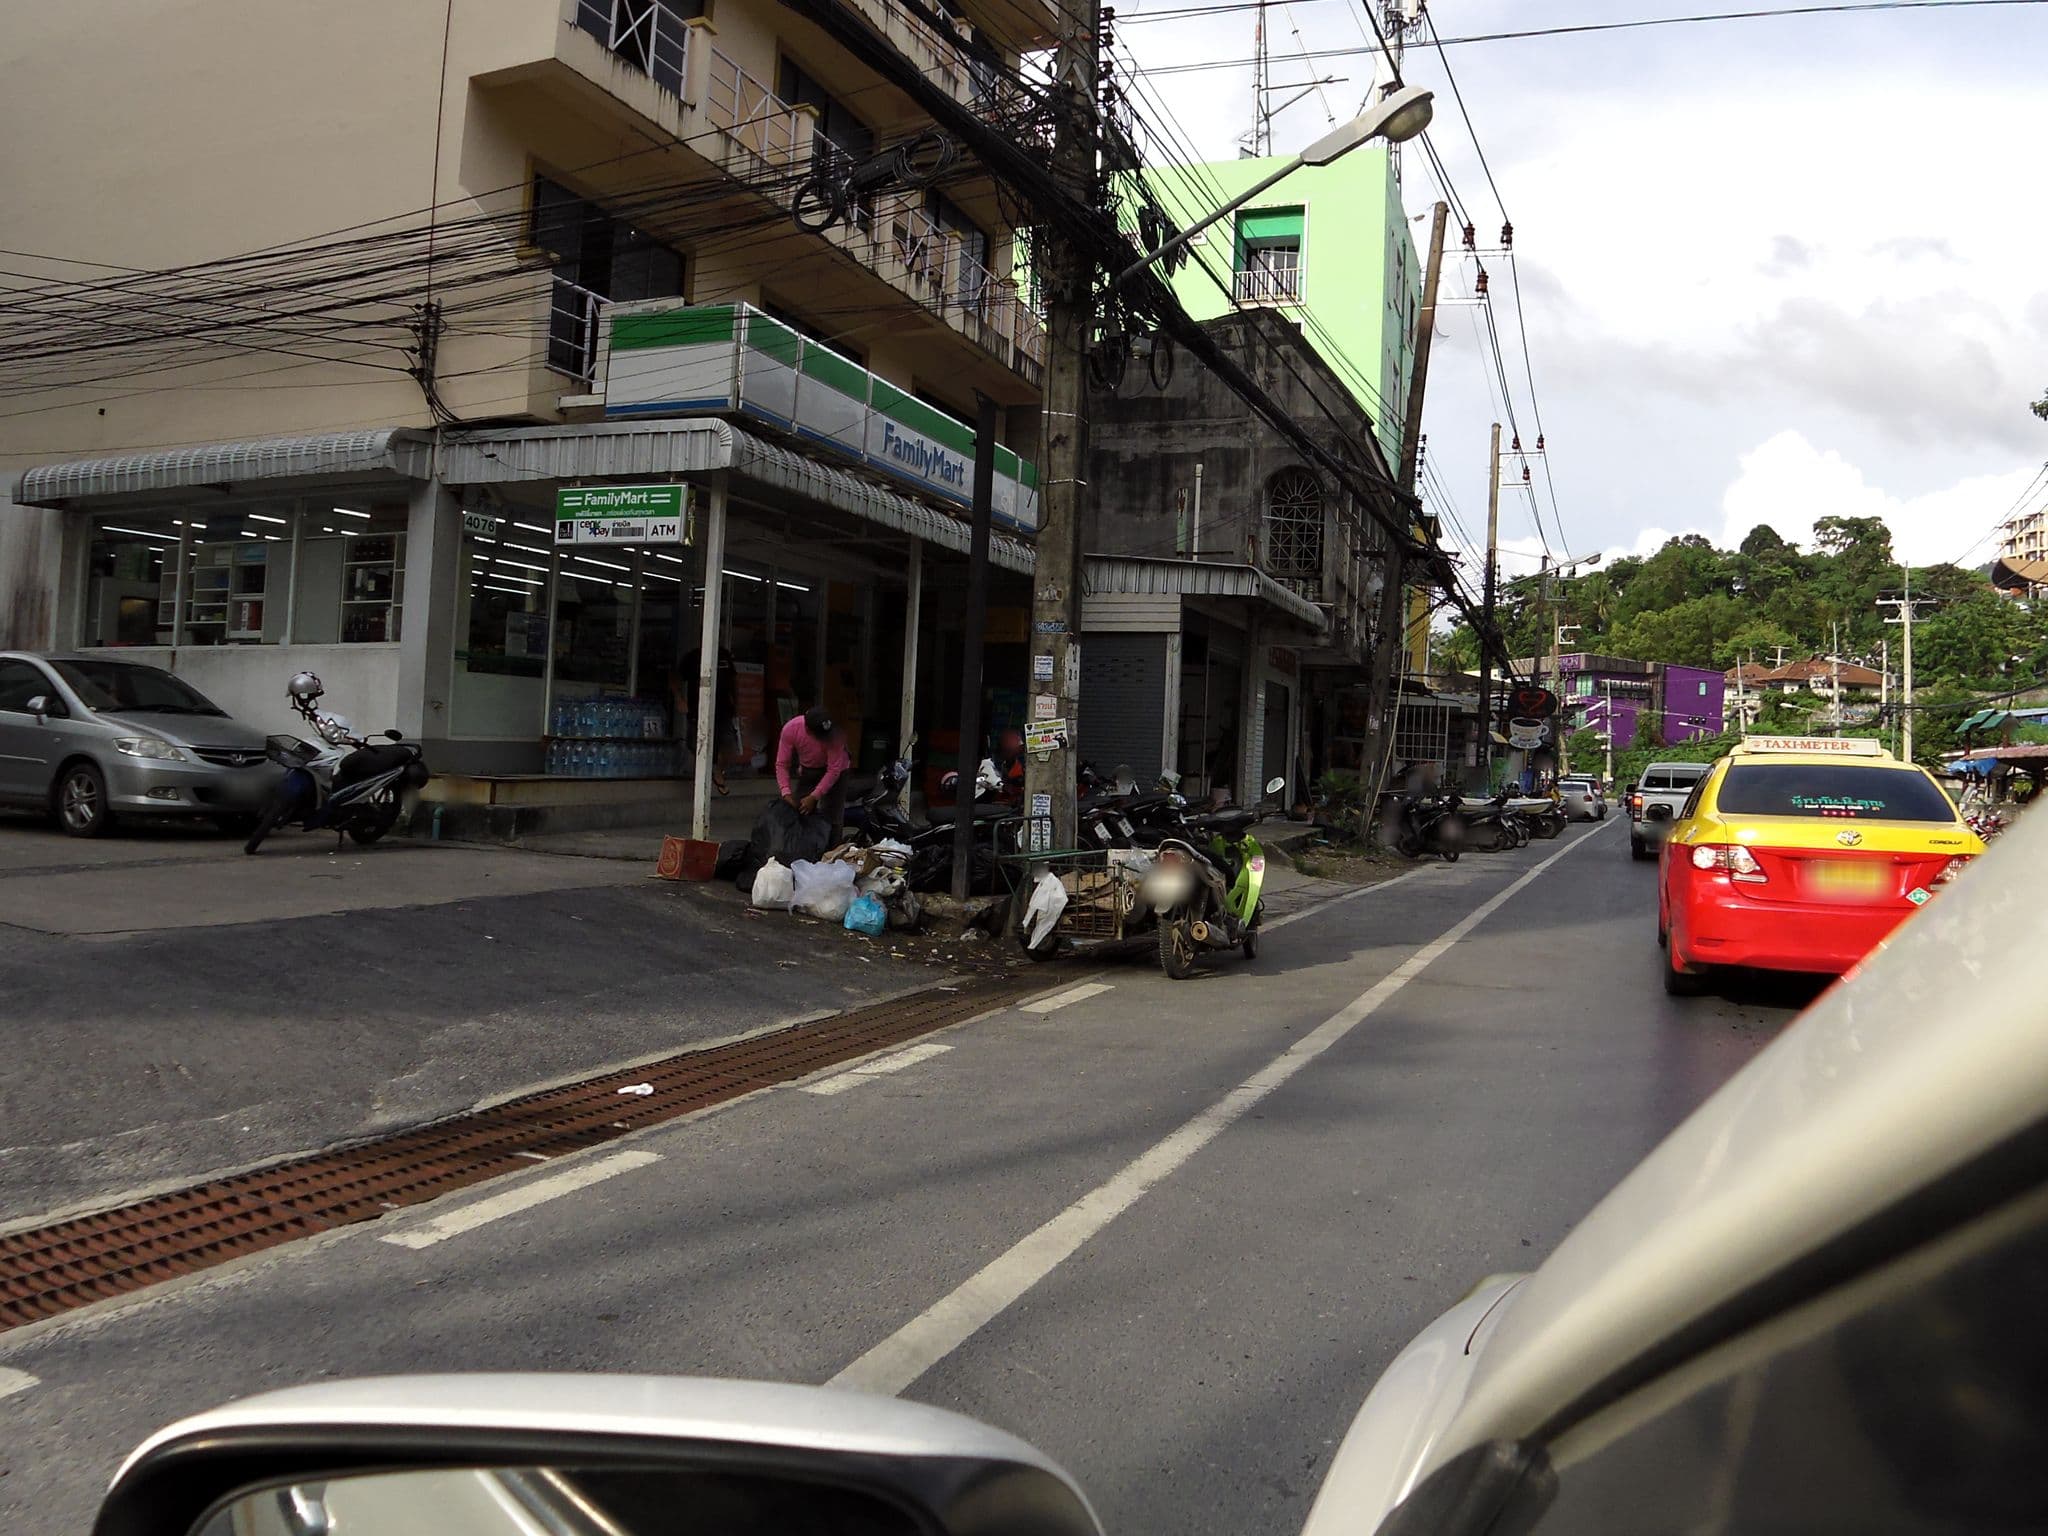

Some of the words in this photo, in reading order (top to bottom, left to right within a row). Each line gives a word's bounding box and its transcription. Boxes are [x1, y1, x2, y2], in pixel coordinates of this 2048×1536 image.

[883, 422, 964, 487] FamilyMart
[584, 491, 648, 507] FamilyMart
[466, 516, 495, 532] 4076
[651, 524, 676, 537] ATM
